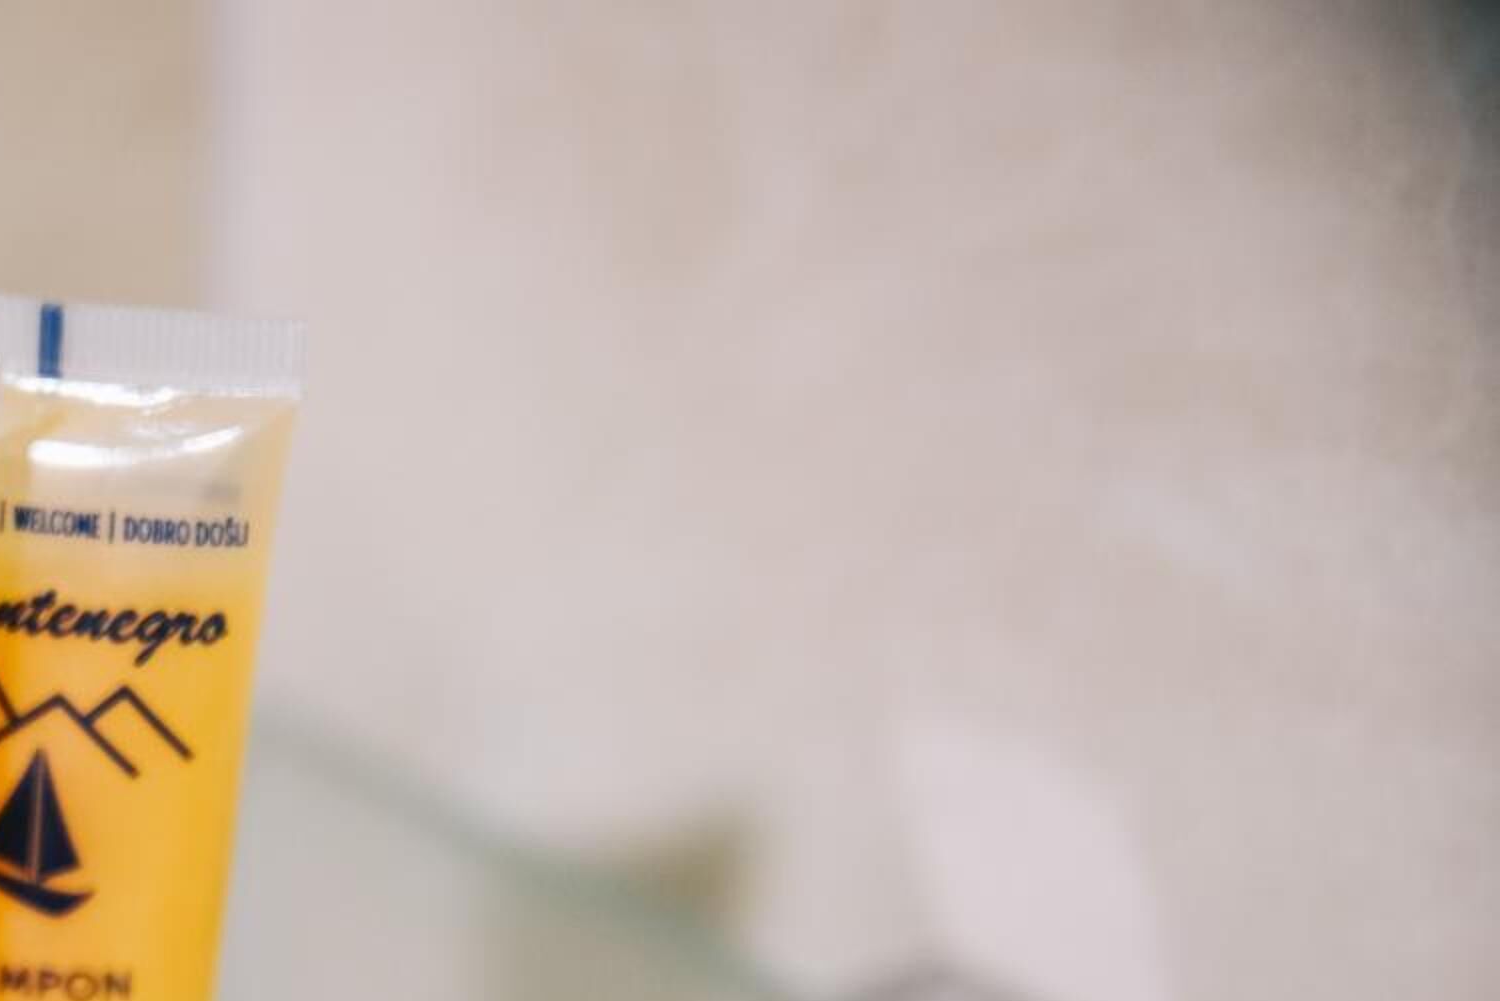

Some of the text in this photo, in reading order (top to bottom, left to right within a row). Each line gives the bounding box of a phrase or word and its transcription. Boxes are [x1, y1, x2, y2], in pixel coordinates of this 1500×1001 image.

[13, 505, 100, 539] WELCOME
[123, 516, 190, 545] DOBRO
[195, 516, 249, 548] DOŠLI
